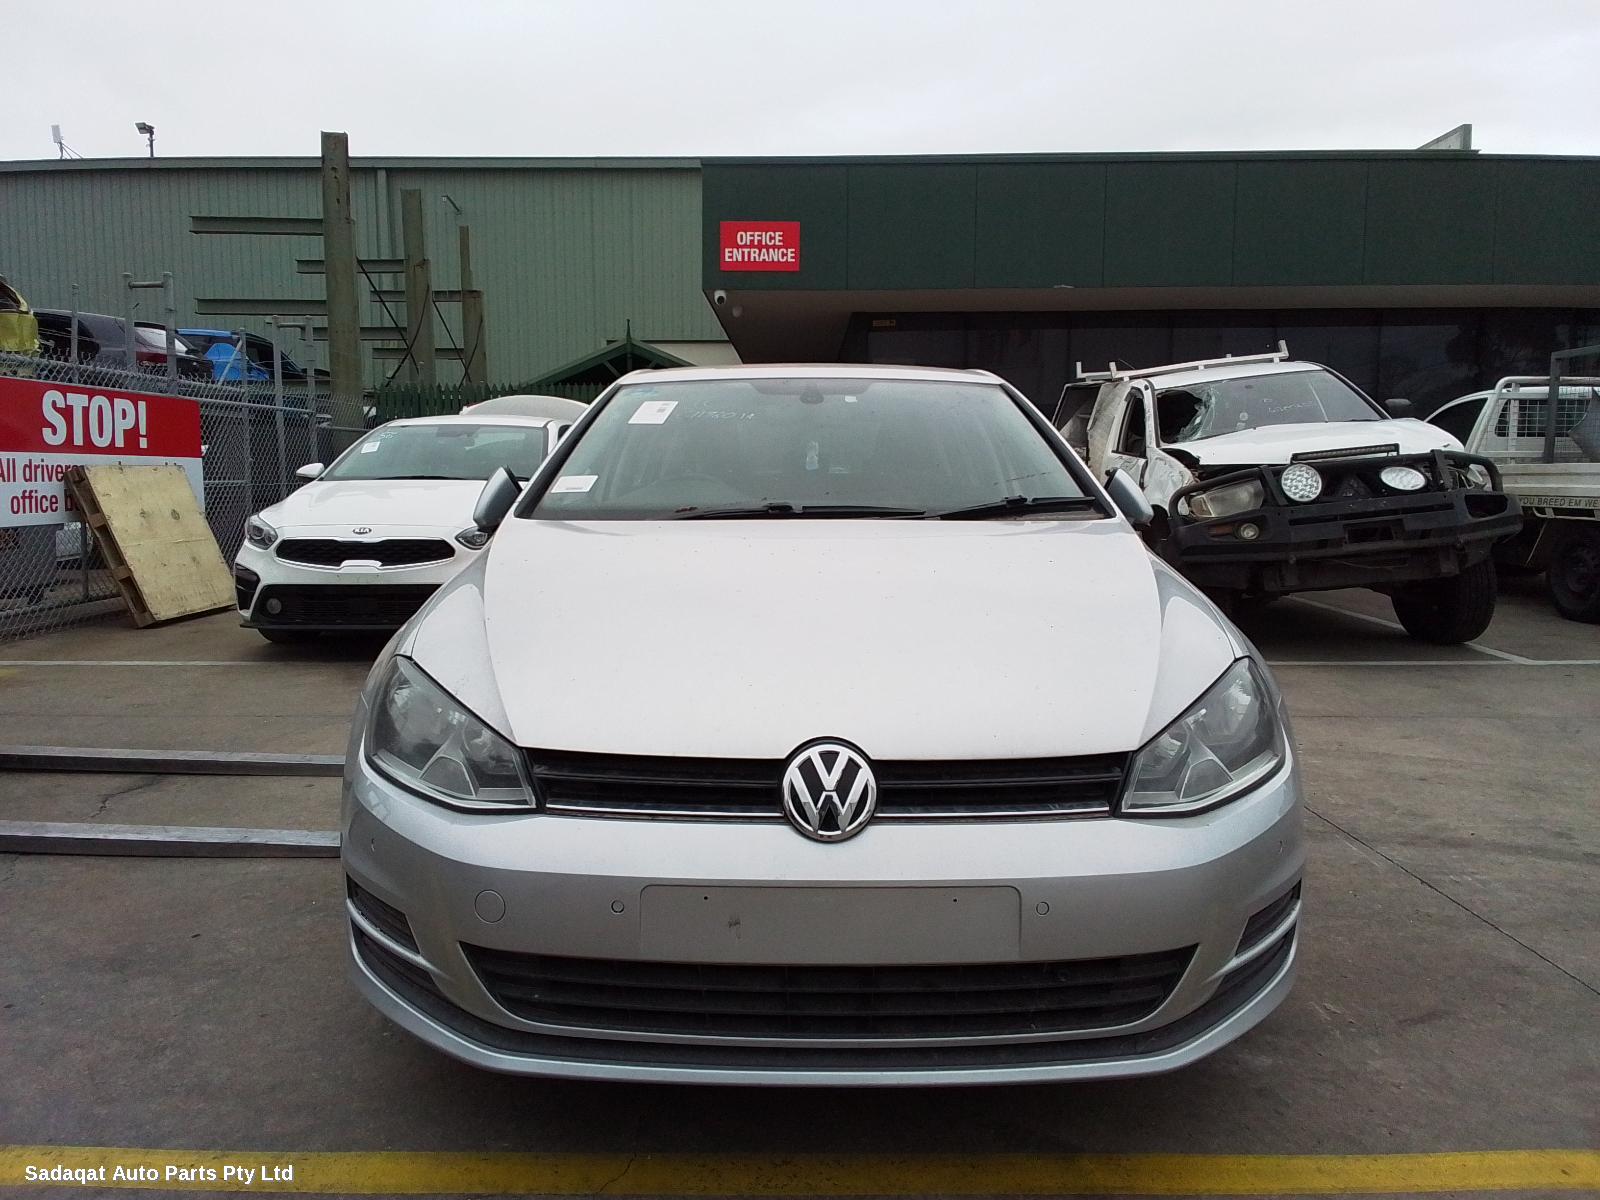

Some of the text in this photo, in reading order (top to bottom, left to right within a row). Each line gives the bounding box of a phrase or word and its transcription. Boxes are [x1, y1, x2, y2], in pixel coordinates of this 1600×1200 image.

[736, 231, 784, 246] OFFICE
[724, 247, 796, 262] ENTRANCE
[42, 389, 148, 449] STOP!
[11, 490, 60, 515] office
[1537, 497, 1566, 507] BREED
[1568, 498, 1582, 507] EM
